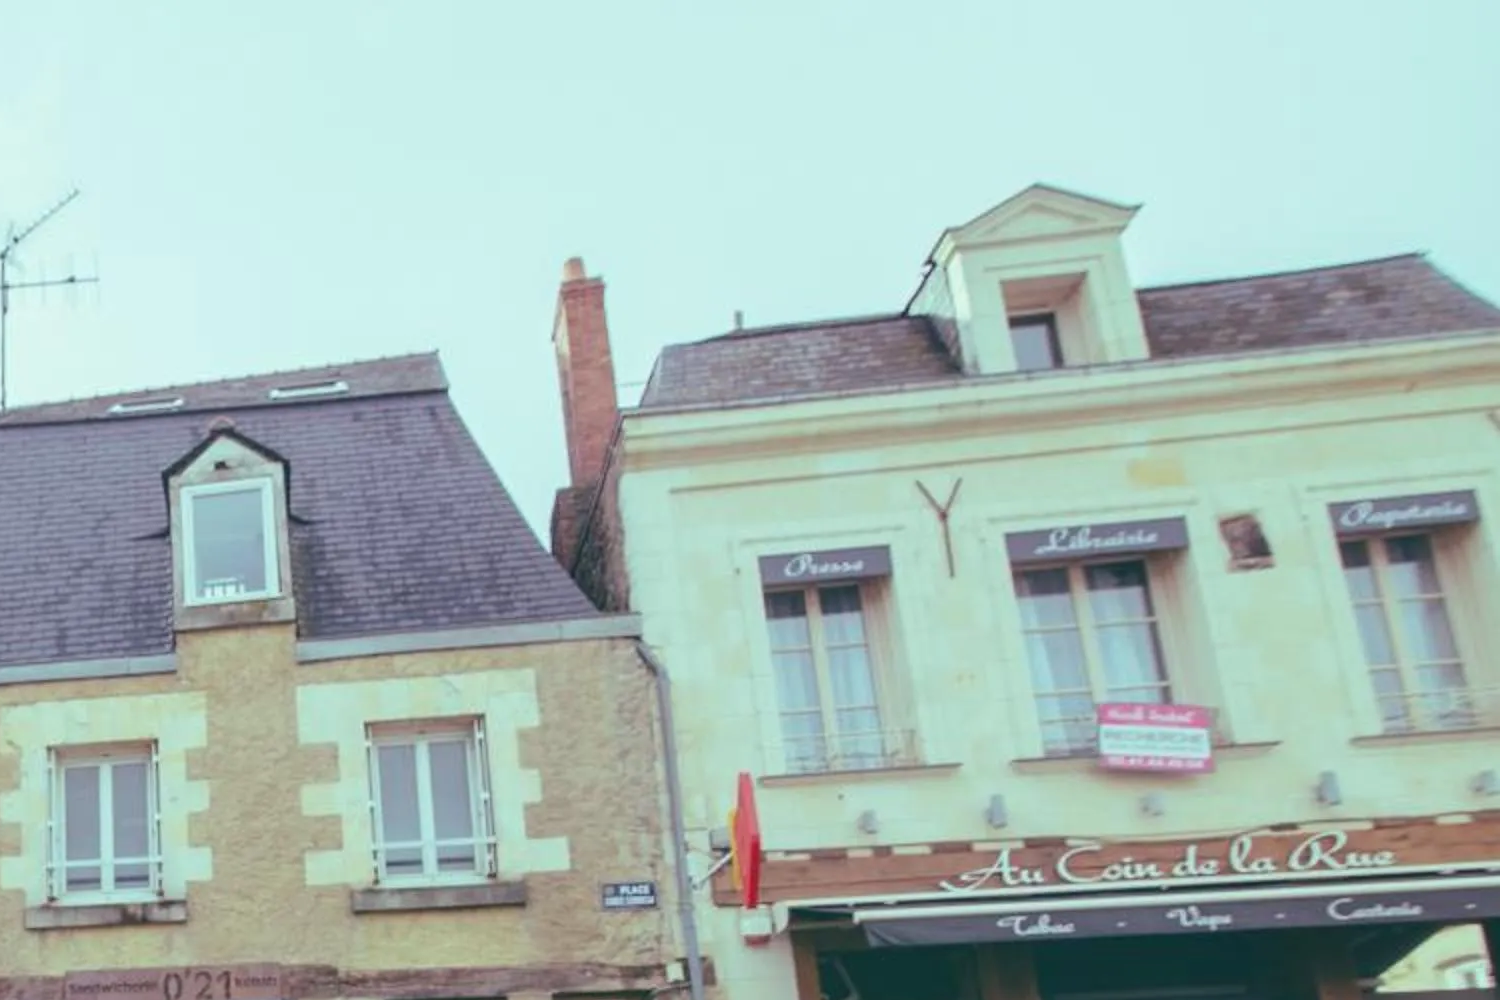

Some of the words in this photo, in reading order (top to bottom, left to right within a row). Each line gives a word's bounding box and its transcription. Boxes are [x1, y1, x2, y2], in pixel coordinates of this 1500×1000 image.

[1033, 526, 1159, 555] Librairie
[783, 553, 865, 577] Presse
[939, 848, 1045, 893] Au
[1056, 844, 1165, 884] Coin
[1171, 844, 1221, 877] de
[1229, 834, 1279, 874] la
[1287, 828, 1397, 871] Rue
[996, 913, 1076, 936] Tabac
